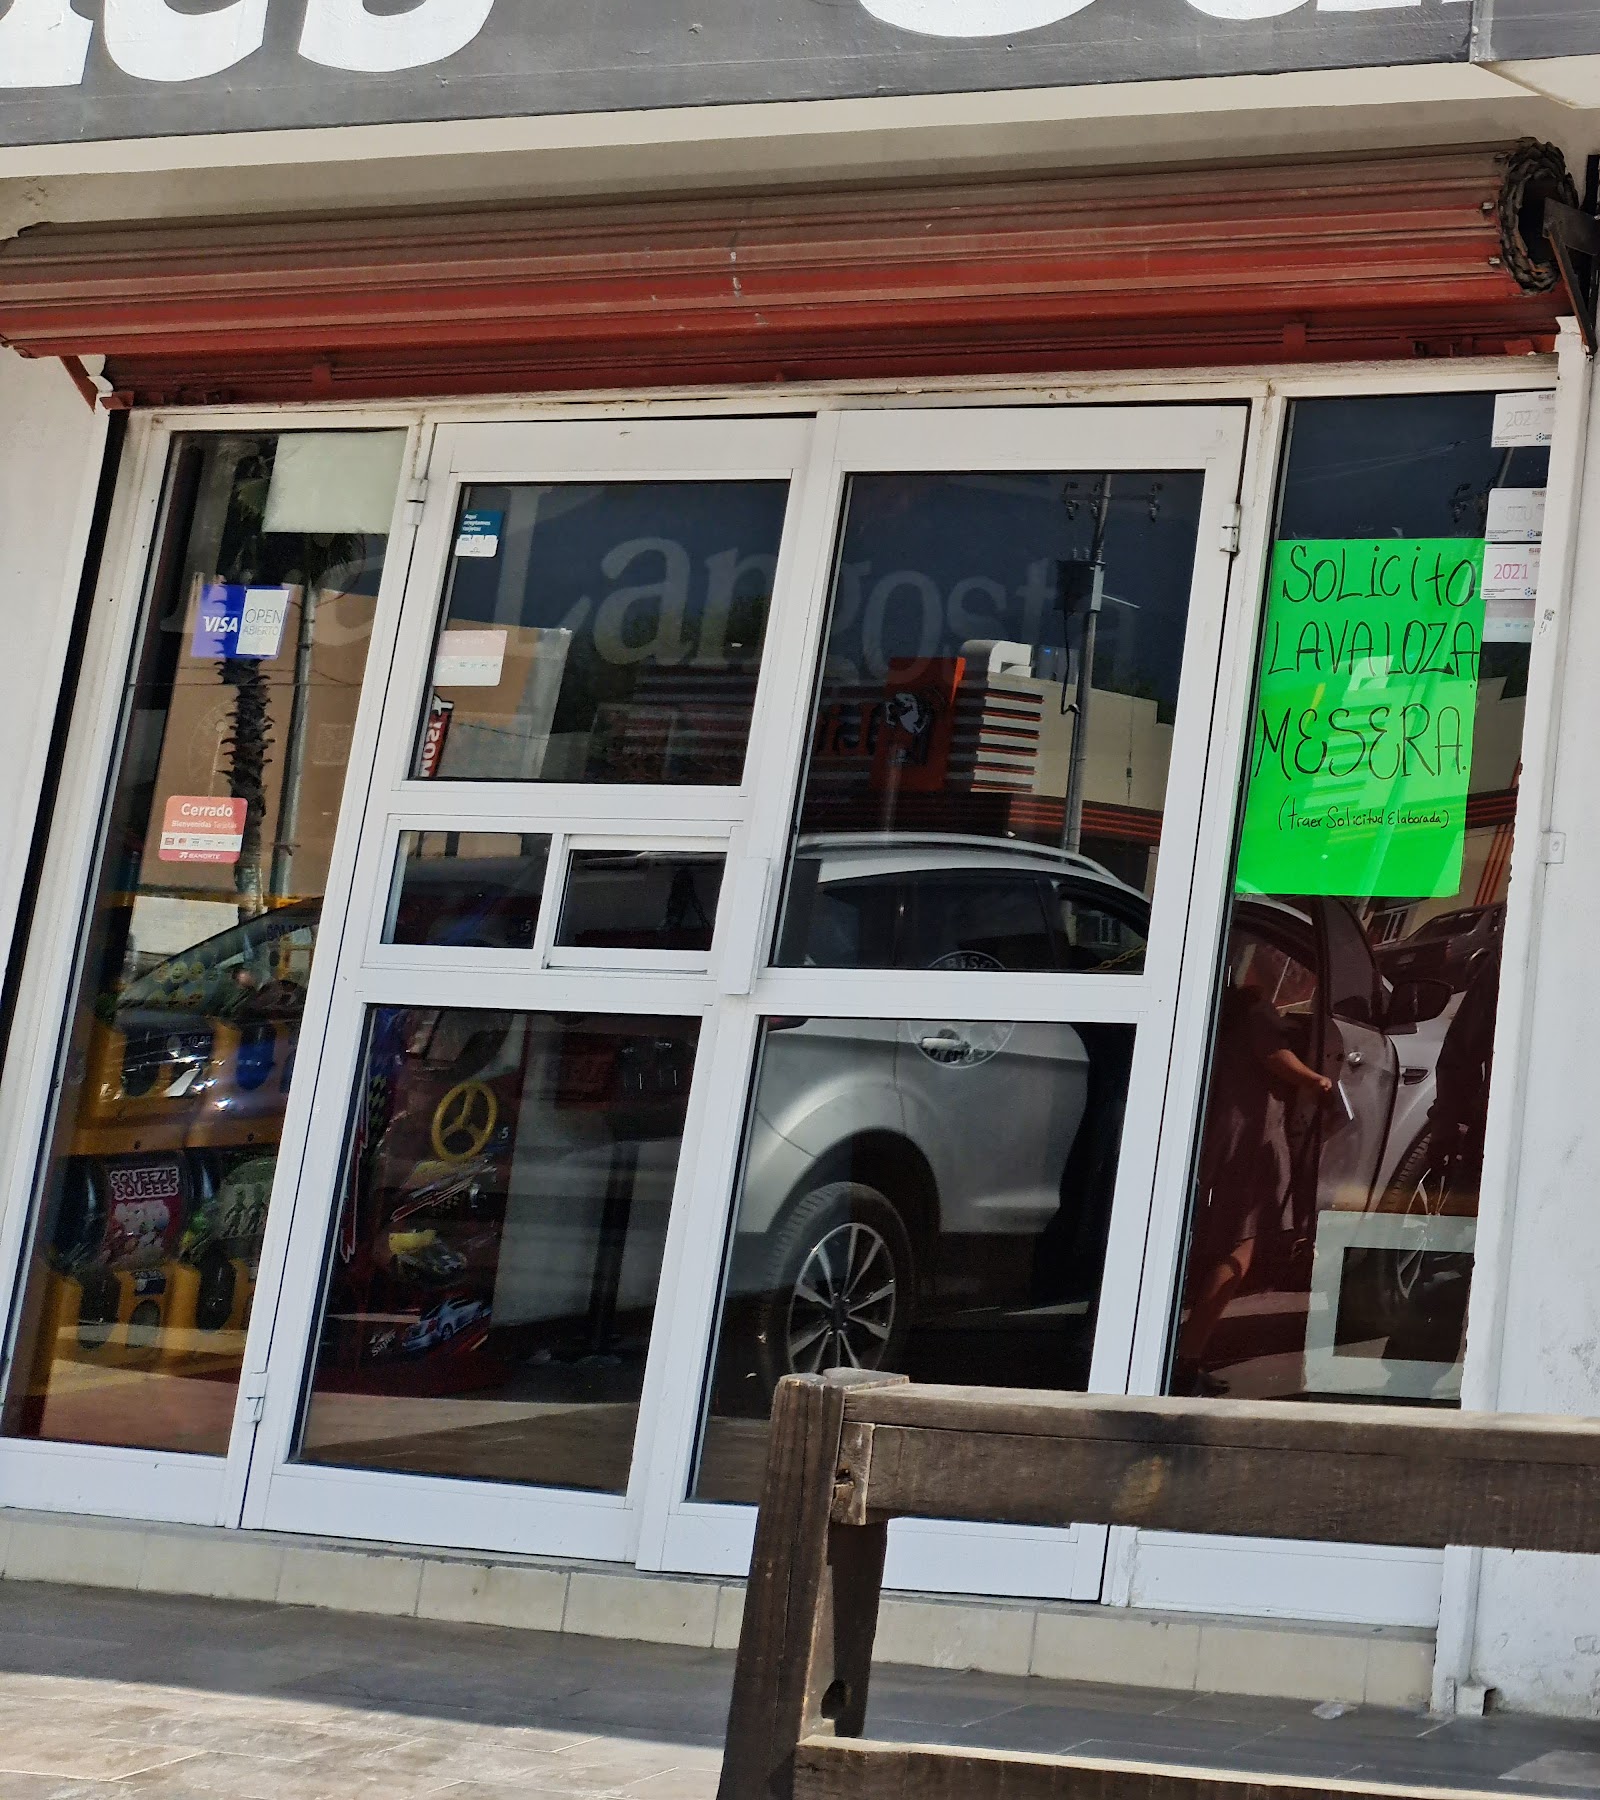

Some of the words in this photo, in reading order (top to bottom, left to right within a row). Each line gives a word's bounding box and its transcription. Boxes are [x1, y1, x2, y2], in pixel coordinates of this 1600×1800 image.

[1494, 563, 1528, 580] 2021
[245, 608, 283, 623] OPEN
[203, 616, 238, 632] VISA
[243, 626, 279, 636] ABIERTO
[181, 803, 233, 817] Cerrado
[1326, 806, 1384, 829] Solicitud
[110, 1167, 179, 1188] SQUEEZIE
